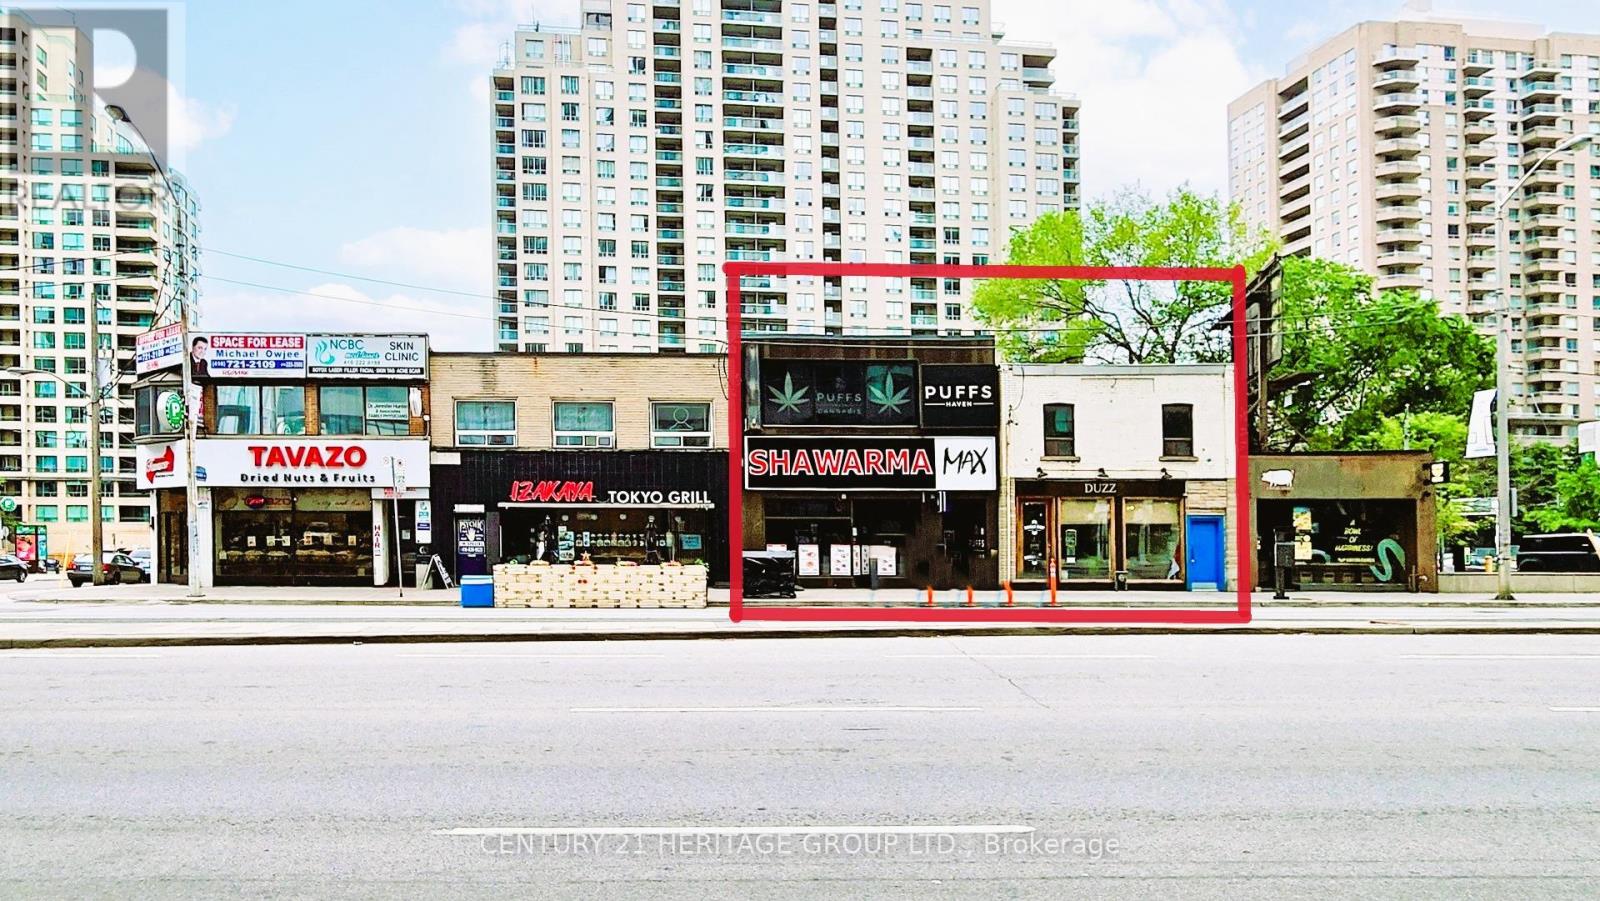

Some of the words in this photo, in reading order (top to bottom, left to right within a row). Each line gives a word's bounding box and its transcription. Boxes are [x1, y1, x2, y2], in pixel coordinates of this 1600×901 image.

[212, 336, 245, 348] SPACE
[247, 336, 268, 348] FOR
[270, 336, 302, 348] LEASE
[329, 339, 364, 350] NCBC
[389, 341, 414, 351] SKIN
[216, 350, 259, 358] Michael
[265, 350, 300, 360] Owjee
[384, 351, 420, 362] CLINIC
[226, 360, 276, 369] 721-2109
[816, 392, 863, 402] PUFFS
[924, 385, 993, 399] PUFFS
[247, 445, 368, 468] TAVAZO
[943, 447, 989, 476] MAX
[747, 448, 935, 477] SHAWARMA
[240, 473, 279, 484] Dried
[283, 473, 316, 484] Nuts
[319, 473, 330, 483] &
[333, 473, 377, 484] Fruits
[510, 480, 596, 503] IZAKAYA
[607, 490, 664, 504] TOKYO
[668, 490, 712, 504] GRILL
[1084, 483, 1118, 494] DUZZ
